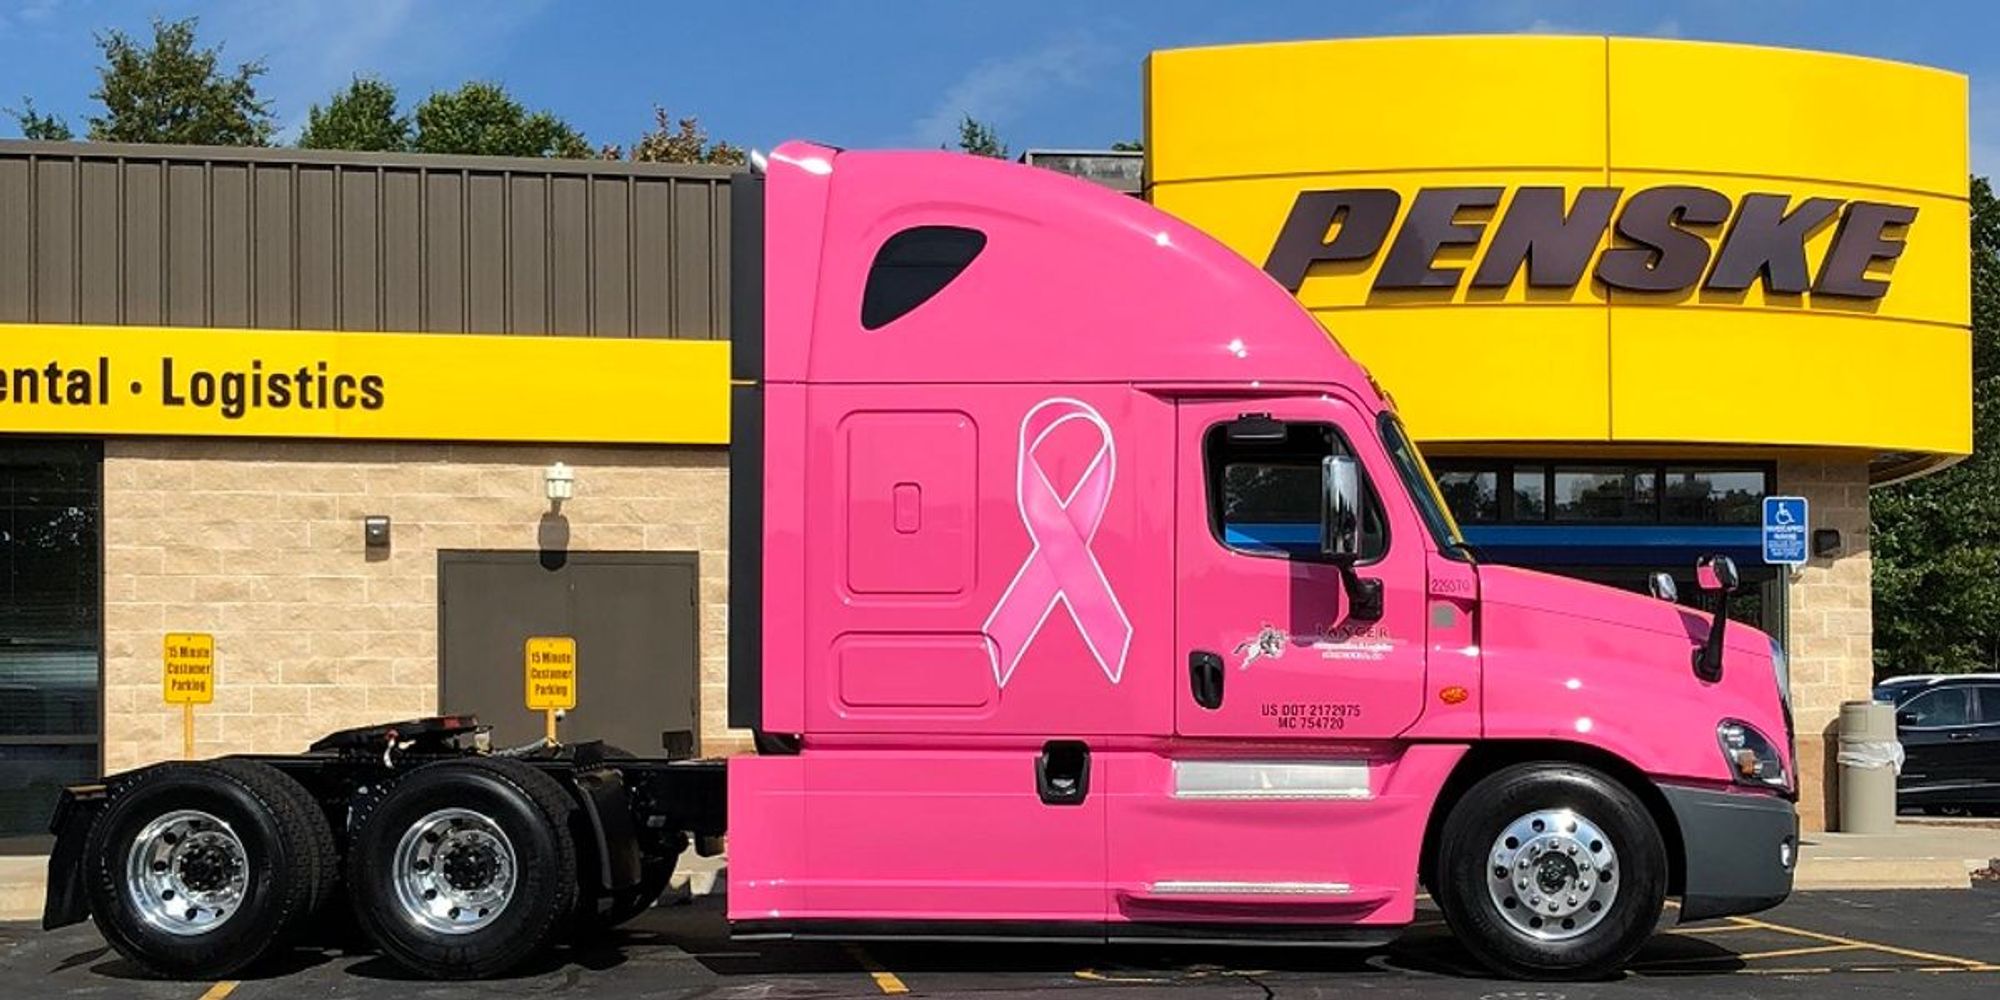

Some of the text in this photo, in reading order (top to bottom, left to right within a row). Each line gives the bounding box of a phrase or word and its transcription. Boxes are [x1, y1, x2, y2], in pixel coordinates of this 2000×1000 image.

[1263, 186, 1918, 297] PENSKE
[162, 357, 385, 420] Logistics
[180, 646, 209, 657] Minute
[531, 651, 571, 664] 15 Minute
[167, 662, 210, 674] Customer
[531, 667, 572, 679] Customer
[172, 679, 205, 692] Parking
[535, 684, 567, 696] Parking
[1261, 704, 1278, 716] US
[1282, 704, 1306, 716] DOT
[1278, 717, 1297, 729] MC
